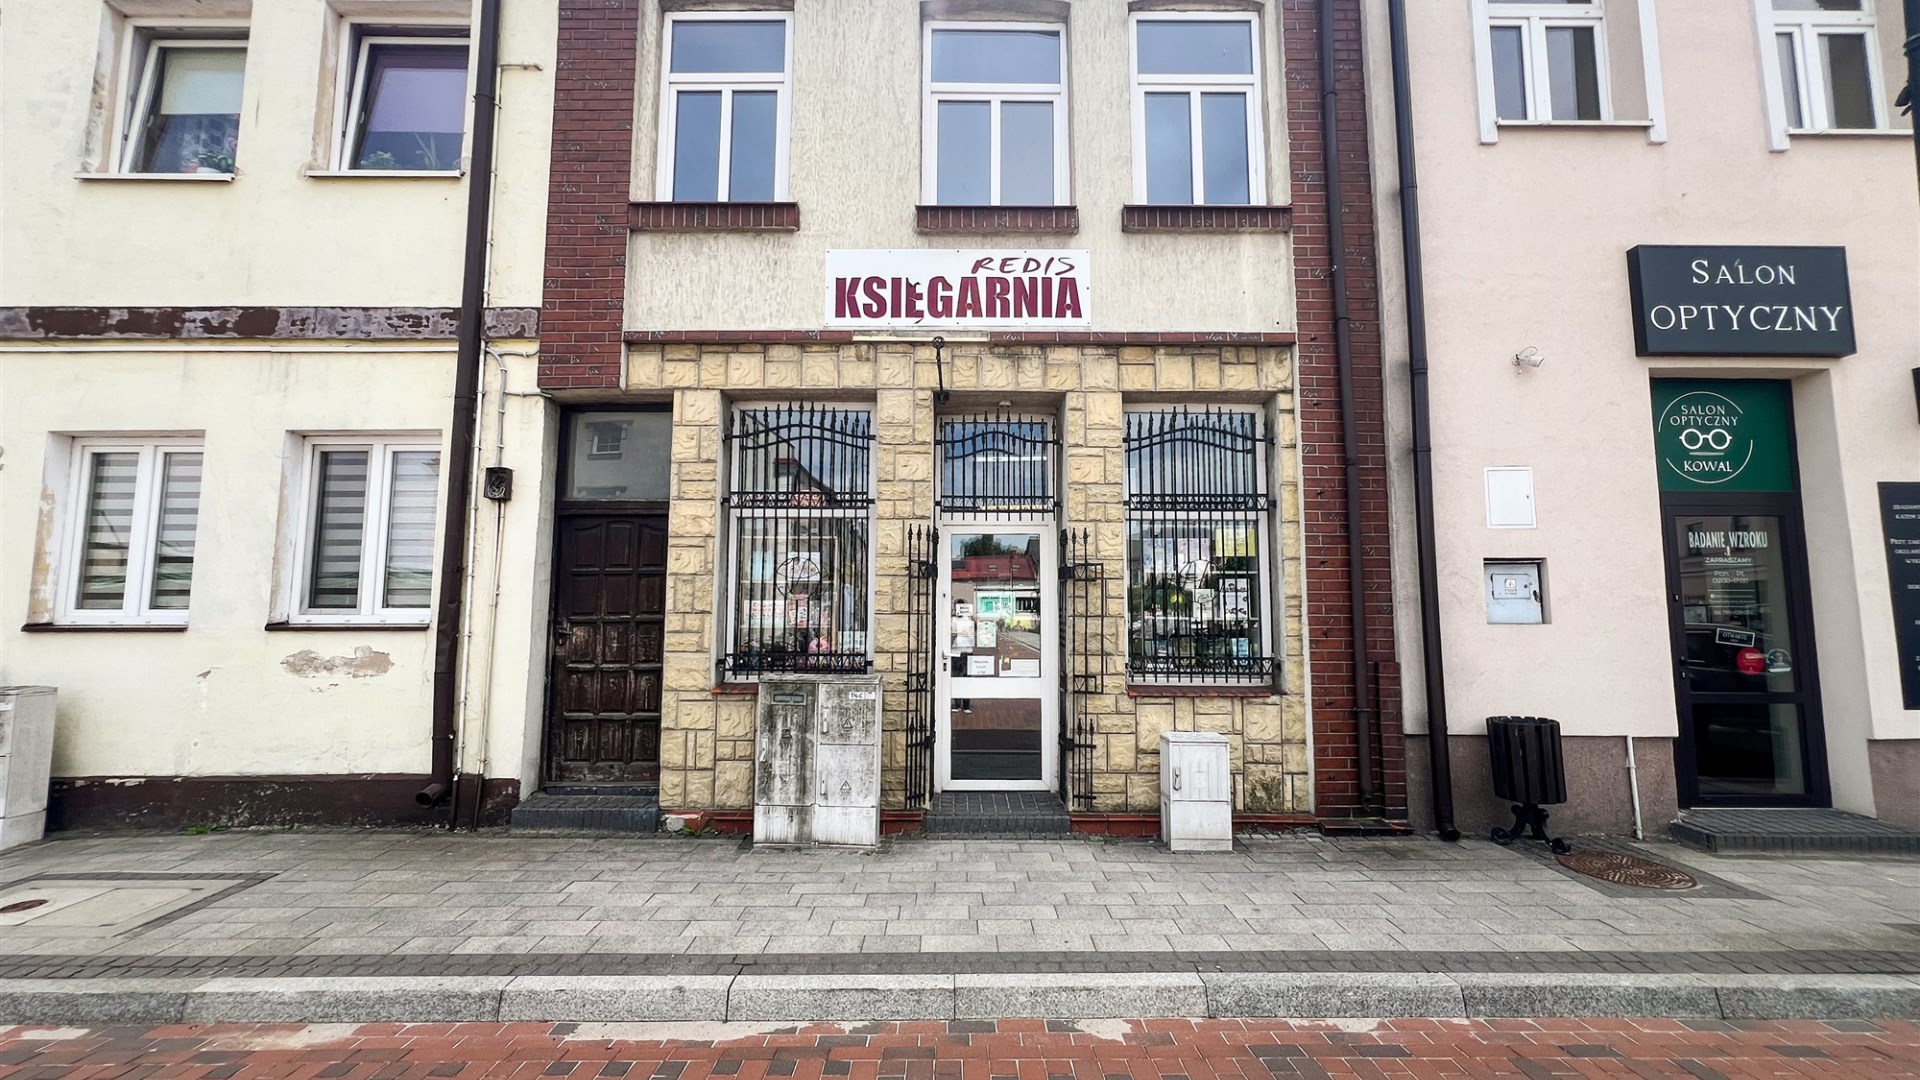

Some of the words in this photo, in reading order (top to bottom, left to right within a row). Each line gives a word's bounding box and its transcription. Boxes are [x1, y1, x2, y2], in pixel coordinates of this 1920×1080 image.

[971, 257, 1075, 276] REDIS
[1691, 259, 1796, 285] SALON
[835, 276, 1083, 324] KSIĘGARNIA
[1650, 305, 1843, 331] OPTYCZNY
[1681, 404, 1725, 415] SALON
[1670, 415, 1738, 426] OPTYCZNY
[1683, 460, 1733, 472] KOWAL
[1688, 531, 1725, 548] BADANIE
[1728, 531, 1768, 548] WZROKU
